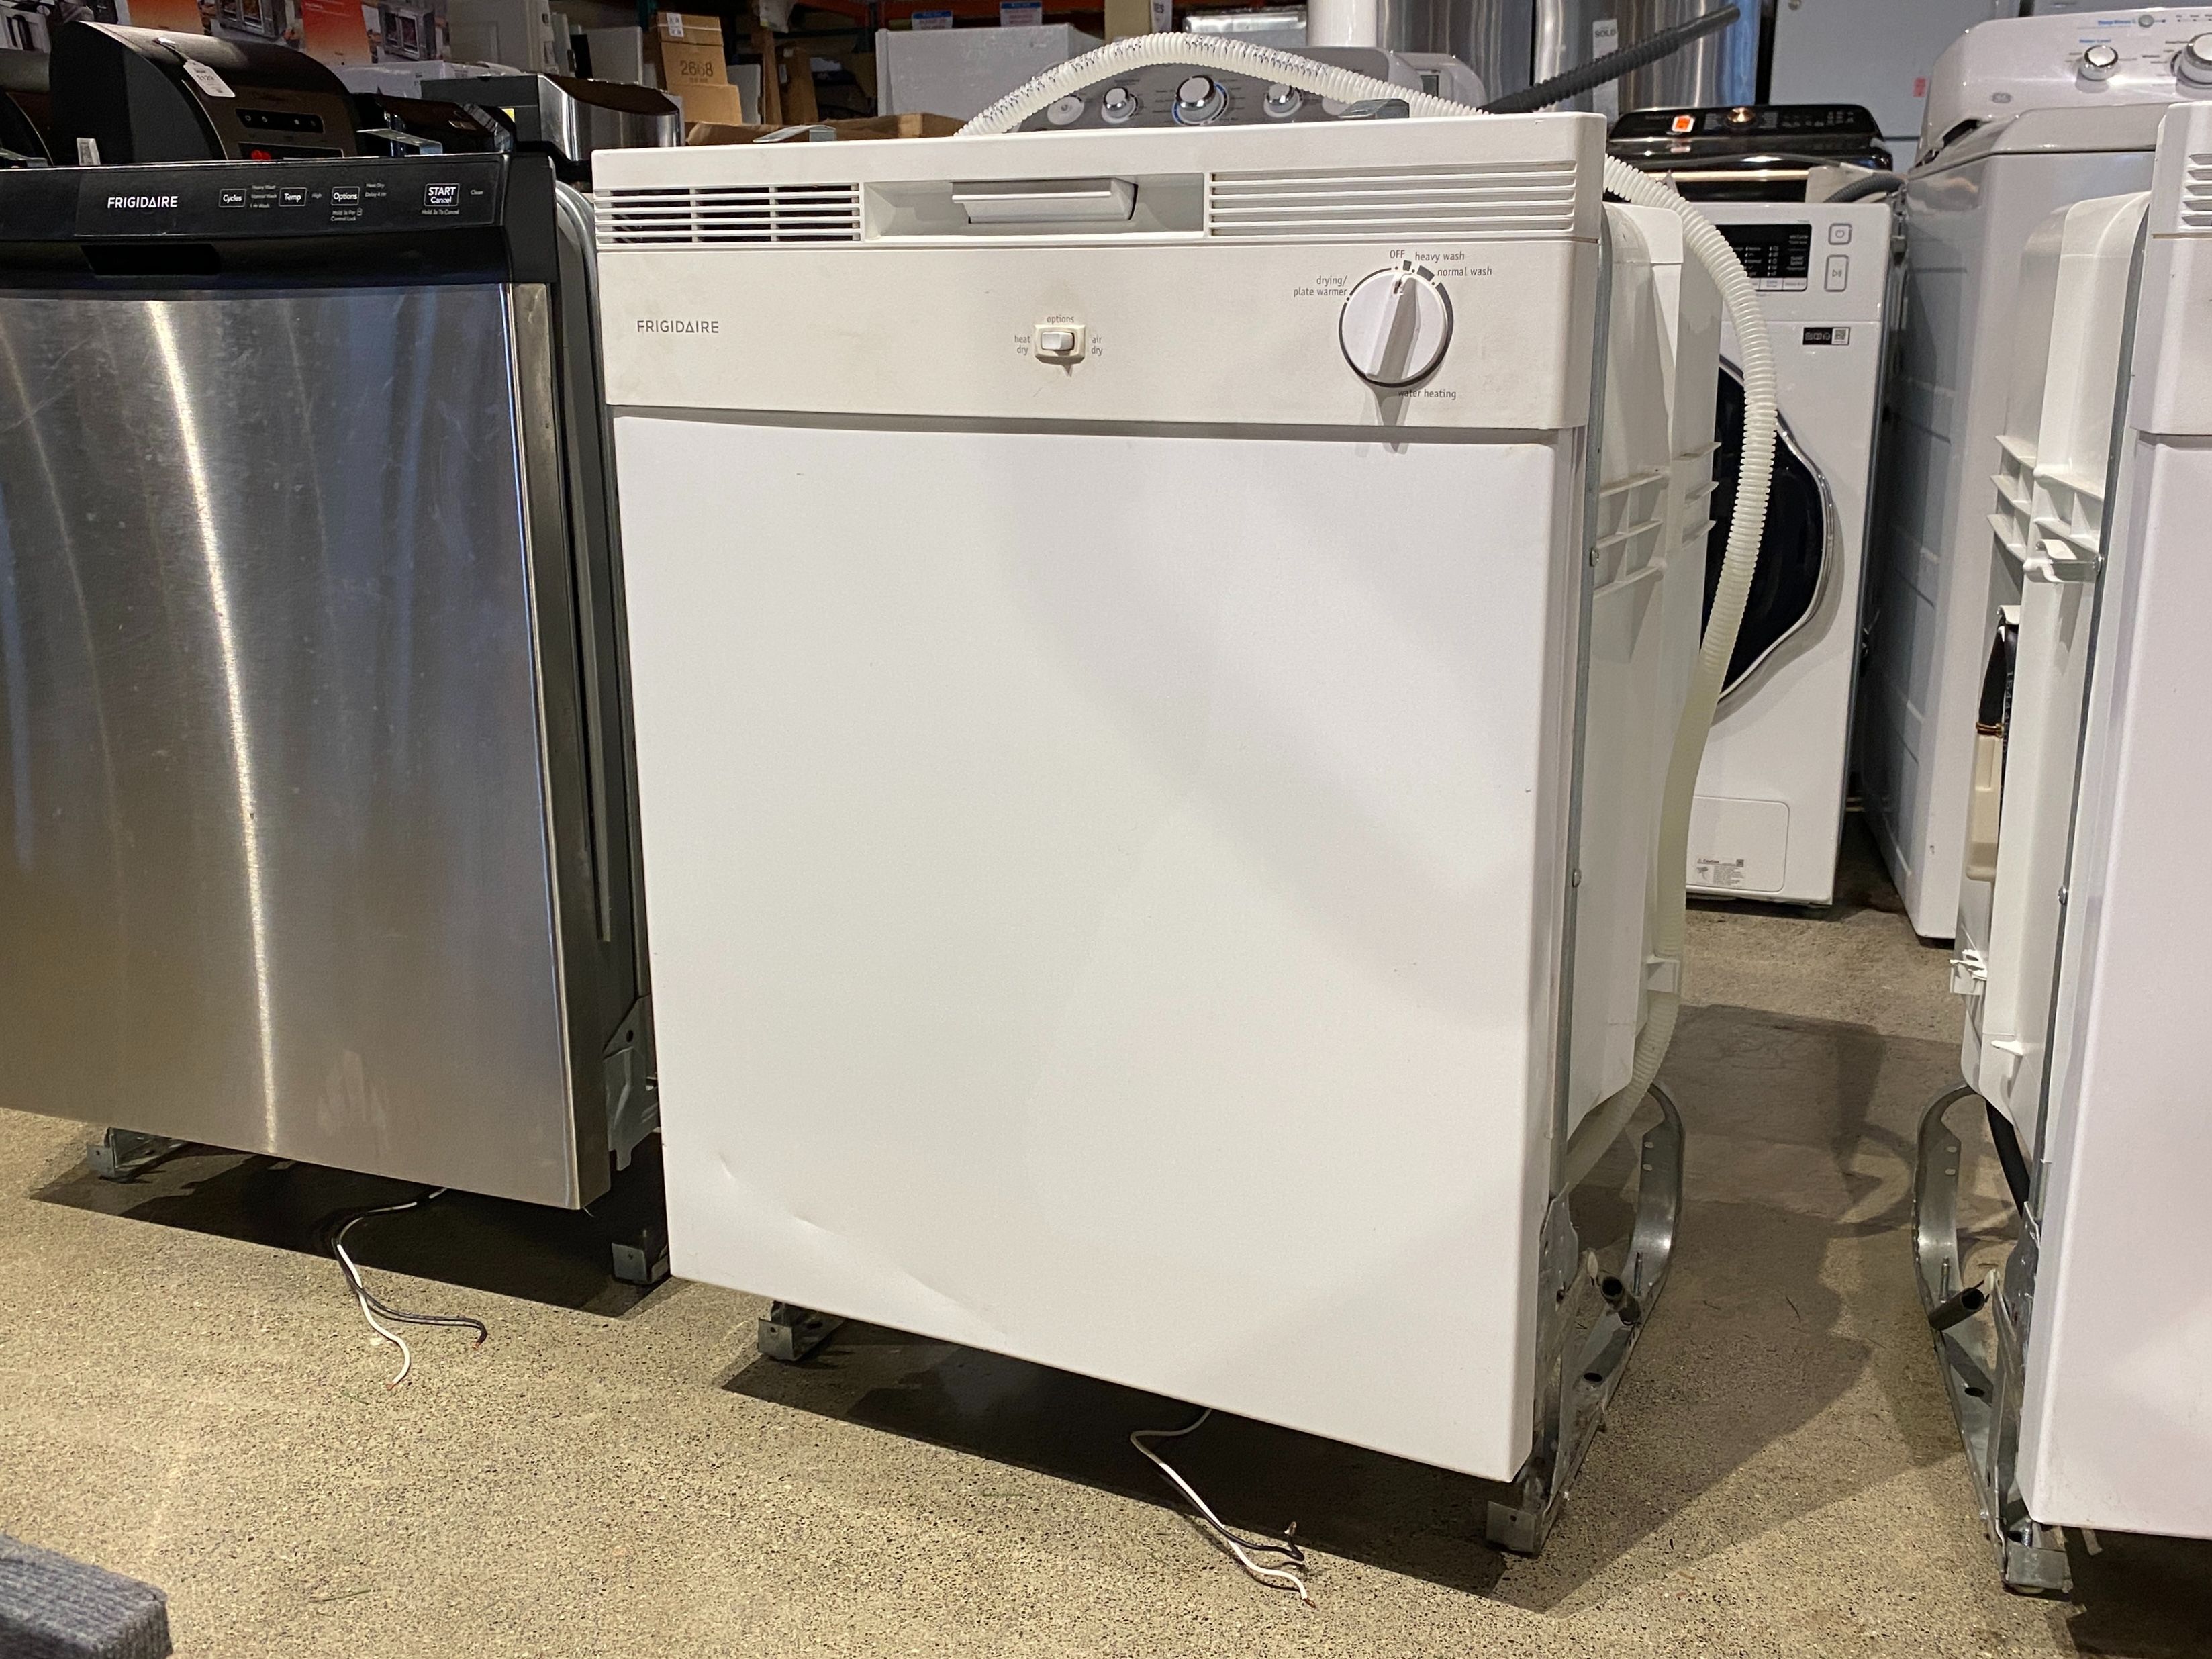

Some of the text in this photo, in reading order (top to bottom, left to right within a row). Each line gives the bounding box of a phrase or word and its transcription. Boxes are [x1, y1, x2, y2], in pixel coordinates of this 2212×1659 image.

[333, 191, 358, 202] Options
[428, 186, 457, 196] START
[107, 195, 179, 209] FRIGIDAIRE
[222, 193, 242, 203] Cycles
[284, 193, 302, 203] Temp
[430, 196, 452, 204] Cancel
[1389, 249, 1406, 259] OFF
[1414, 250, 1465, 262] heavy wash
[1437, 266, 1492, 277] normal wash
[1316, 275, 1348, 286] drying/
[1293, 287, 1347, 297] plate warmer
[1047, 314, 1075, 325] options
[636, 320, 720, 334] FRIGIDAIRE
[1014, 335, 1031, 344] heat
[1092, 336, 1102, 344] air
[1016, 345, 1029, 356] dry
[1091, 346, 1103, 357] dry
[1398, 389, 1457, 401] water heating
